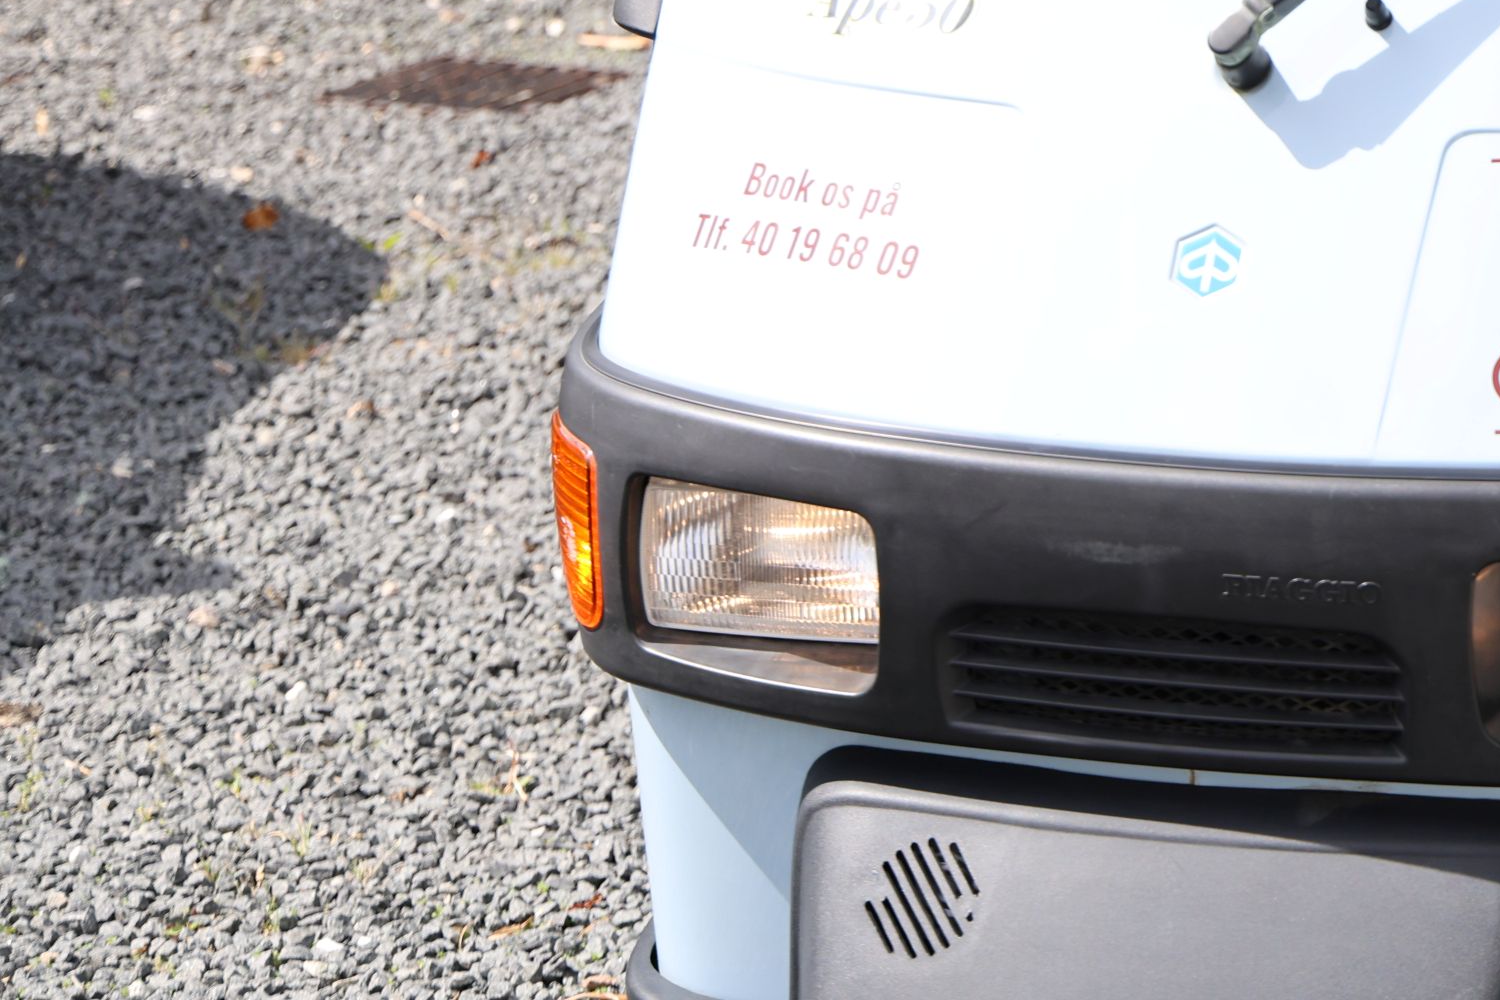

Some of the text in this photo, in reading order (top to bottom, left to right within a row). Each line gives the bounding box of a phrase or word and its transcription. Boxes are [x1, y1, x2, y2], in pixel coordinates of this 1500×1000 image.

[743, 161, 902, 221] Book os på
[692, 212, 920, 280] Tlf. 40 19 68 09
[1221, 572, 1383, 605] PIAGGIO
